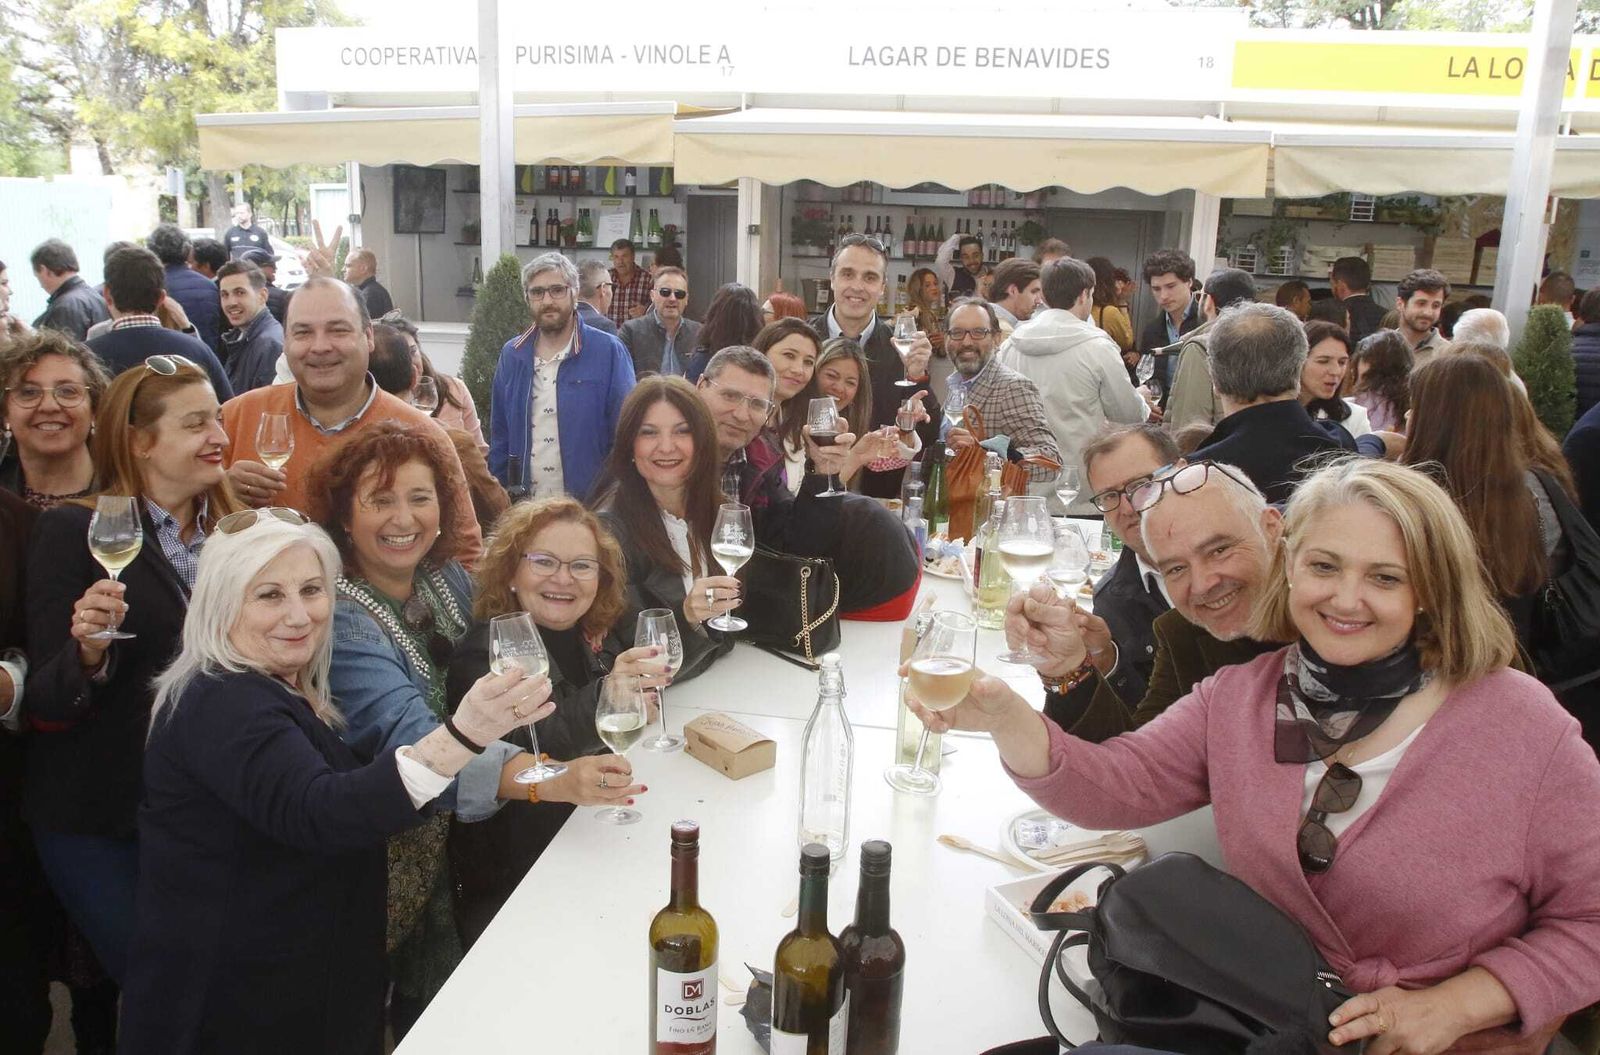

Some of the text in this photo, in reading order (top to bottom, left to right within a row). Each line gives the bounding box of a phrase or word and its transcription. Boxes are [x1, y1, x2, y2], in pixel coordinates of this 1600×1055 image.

[340, 46, 478, 66] COOPERATIVA
[515, 45, 614, 65] PURISIMA
[848, 46, 1110, 69] LAGAR DE BENAVIDES
[1197, 56, 1214, 69] 18
[721, 65, 735, 76] 17
[1448, 56, 1480, 78] LA
